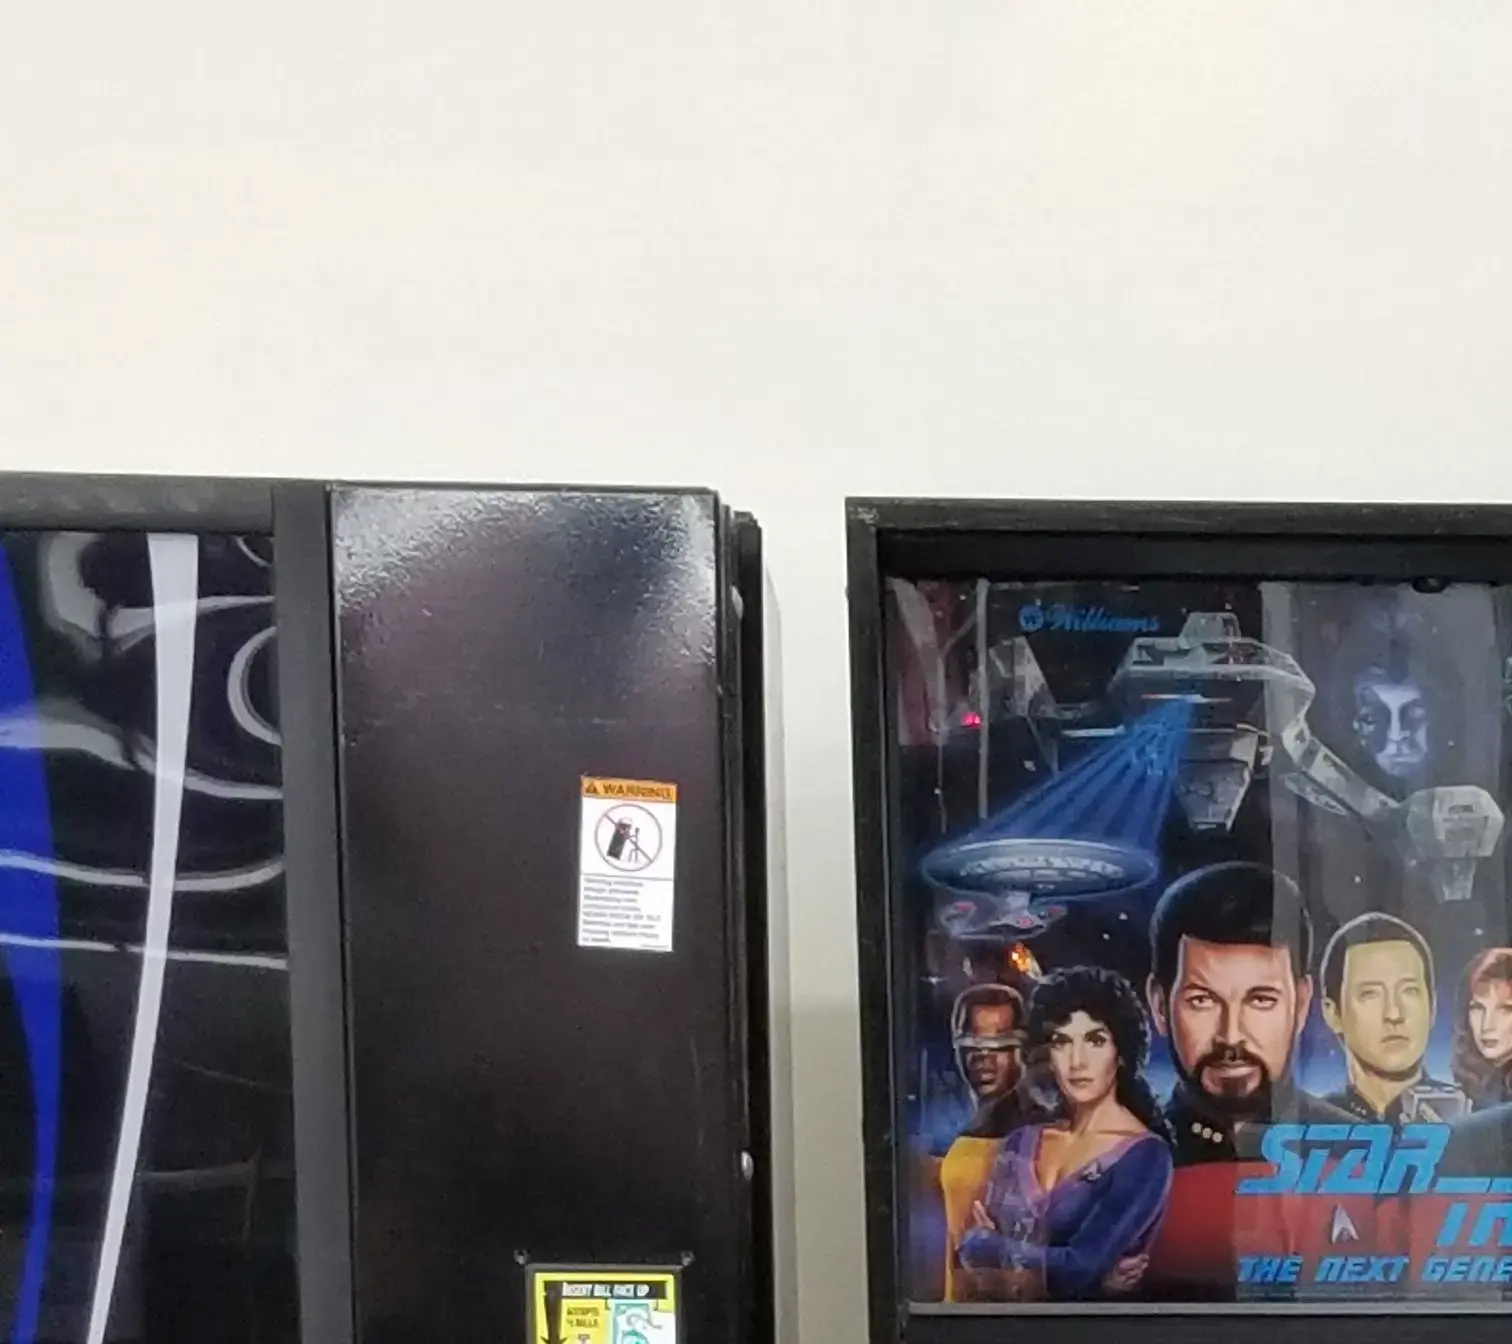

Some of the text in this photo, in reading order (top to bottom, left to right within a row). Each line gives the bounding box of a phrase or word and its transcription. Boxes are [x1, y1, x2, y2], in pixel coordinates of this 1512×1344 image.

[1048, 604, 1160, 632] Williams
[1235, 1123, 1451, 1195] STAR
[1237, 1255, 1302, 1283] THE
[1314, 1255, 1409, 1283] NEXT
